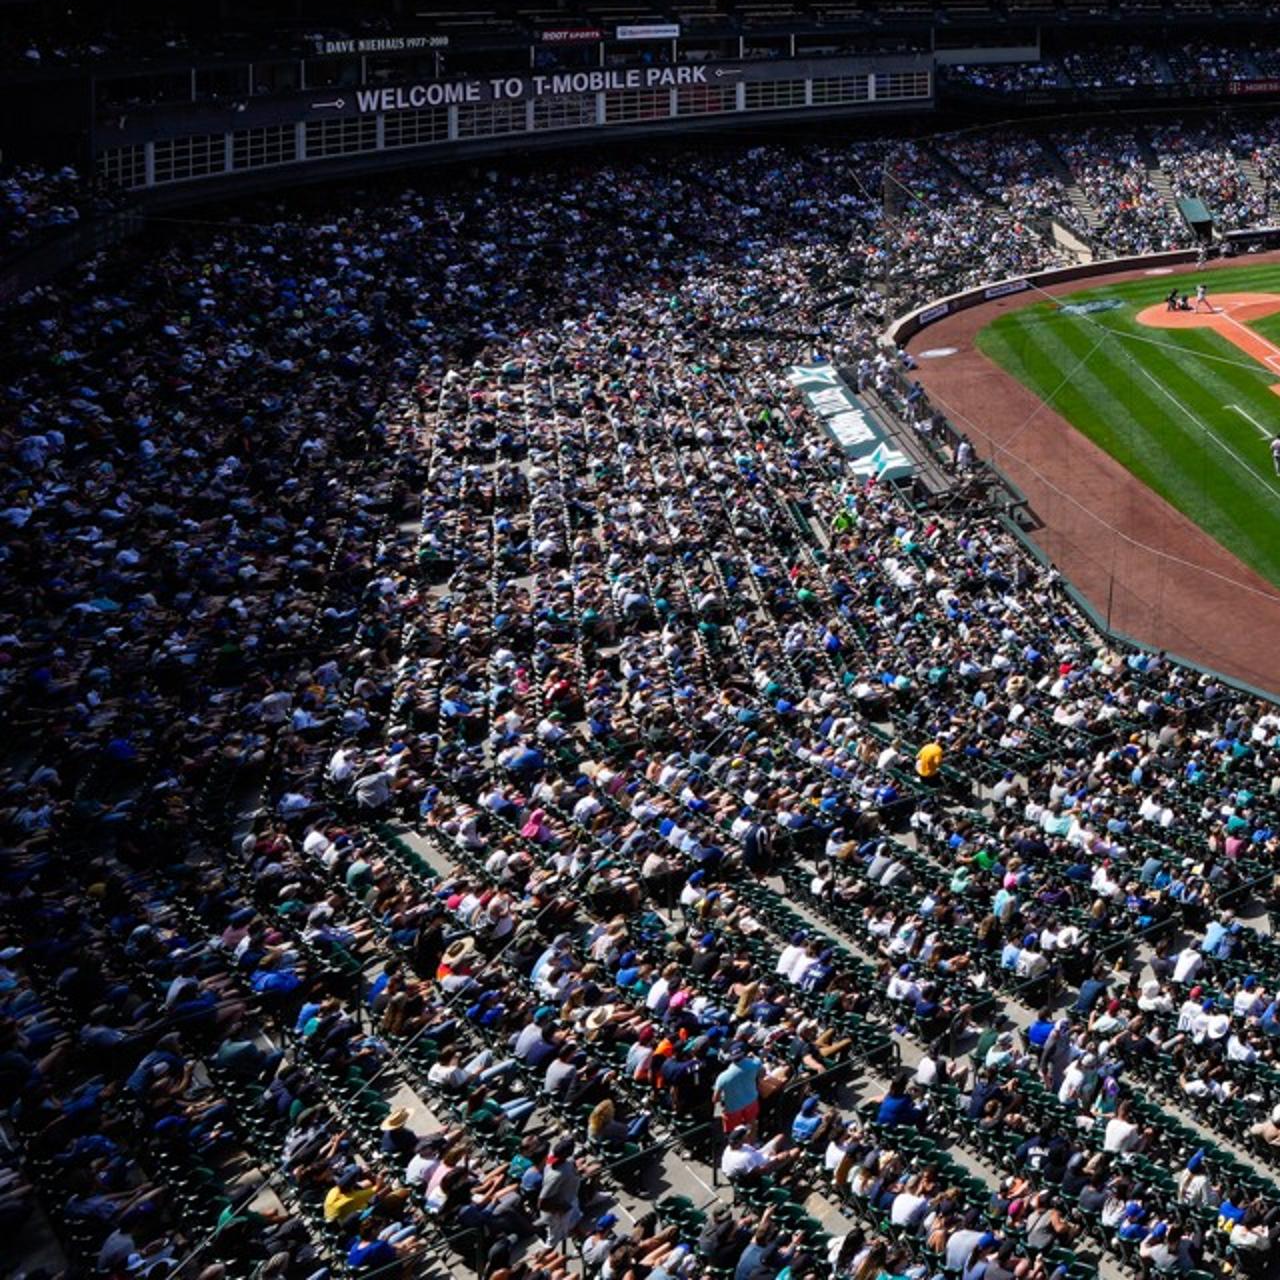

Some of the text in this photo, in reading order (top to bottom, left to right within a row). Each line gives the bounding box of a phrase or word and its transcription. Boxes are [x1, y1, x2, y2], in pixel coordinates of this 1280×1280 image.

[542, 30, 600, 40] ROOT SPORTS
[326, 39, 355, 53] DAVE
[358, 37, 405, 51] NIEHAUS
[356, 65, 707, 112] WELCOME TO T-MOBILE PARK
